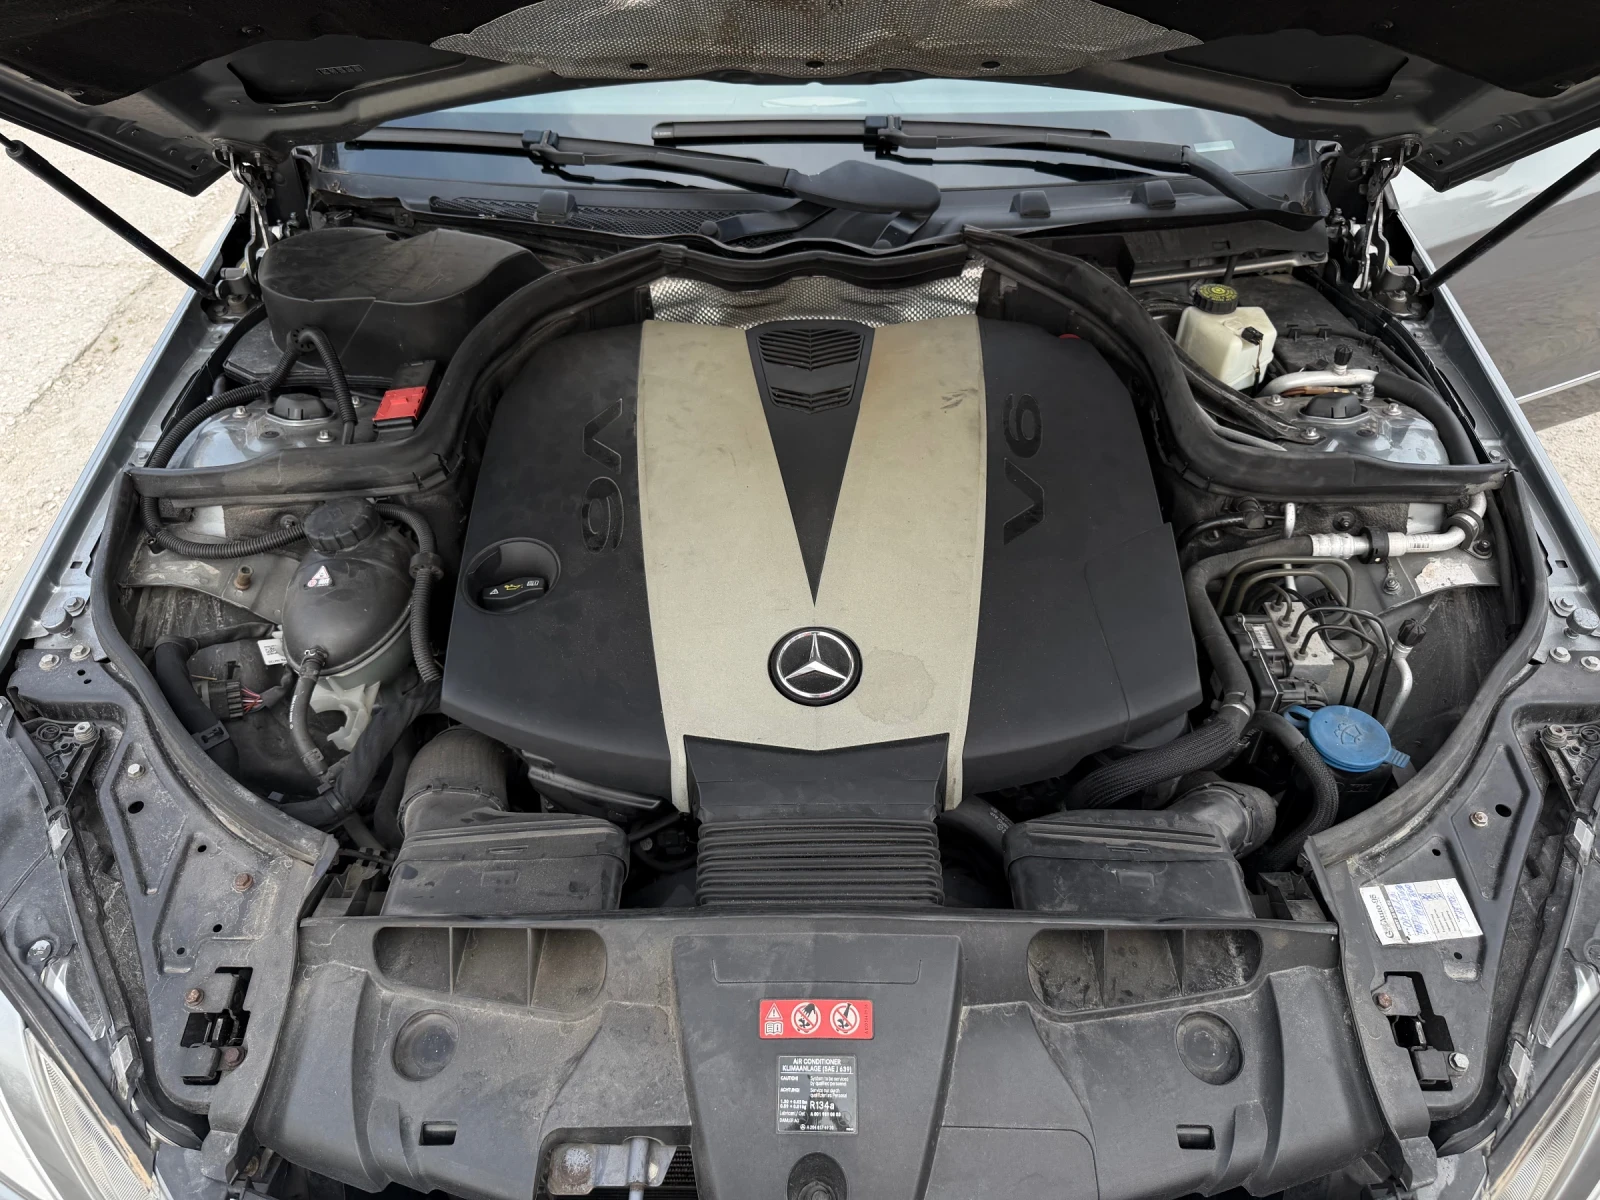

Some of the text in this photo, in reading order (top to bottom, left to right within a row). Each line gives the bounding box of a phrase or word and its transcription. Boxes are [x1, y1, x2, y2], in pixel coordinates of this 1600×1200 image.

[1002, 393, 1044, 546] V6
[577, 397, 625, 554] V6
[803, 1058, 842, 1066] CONDITIONER
[782, 1064, 822, 1072] KLIMAANLAGE
[809, 1101, 835, 1110] R134a
